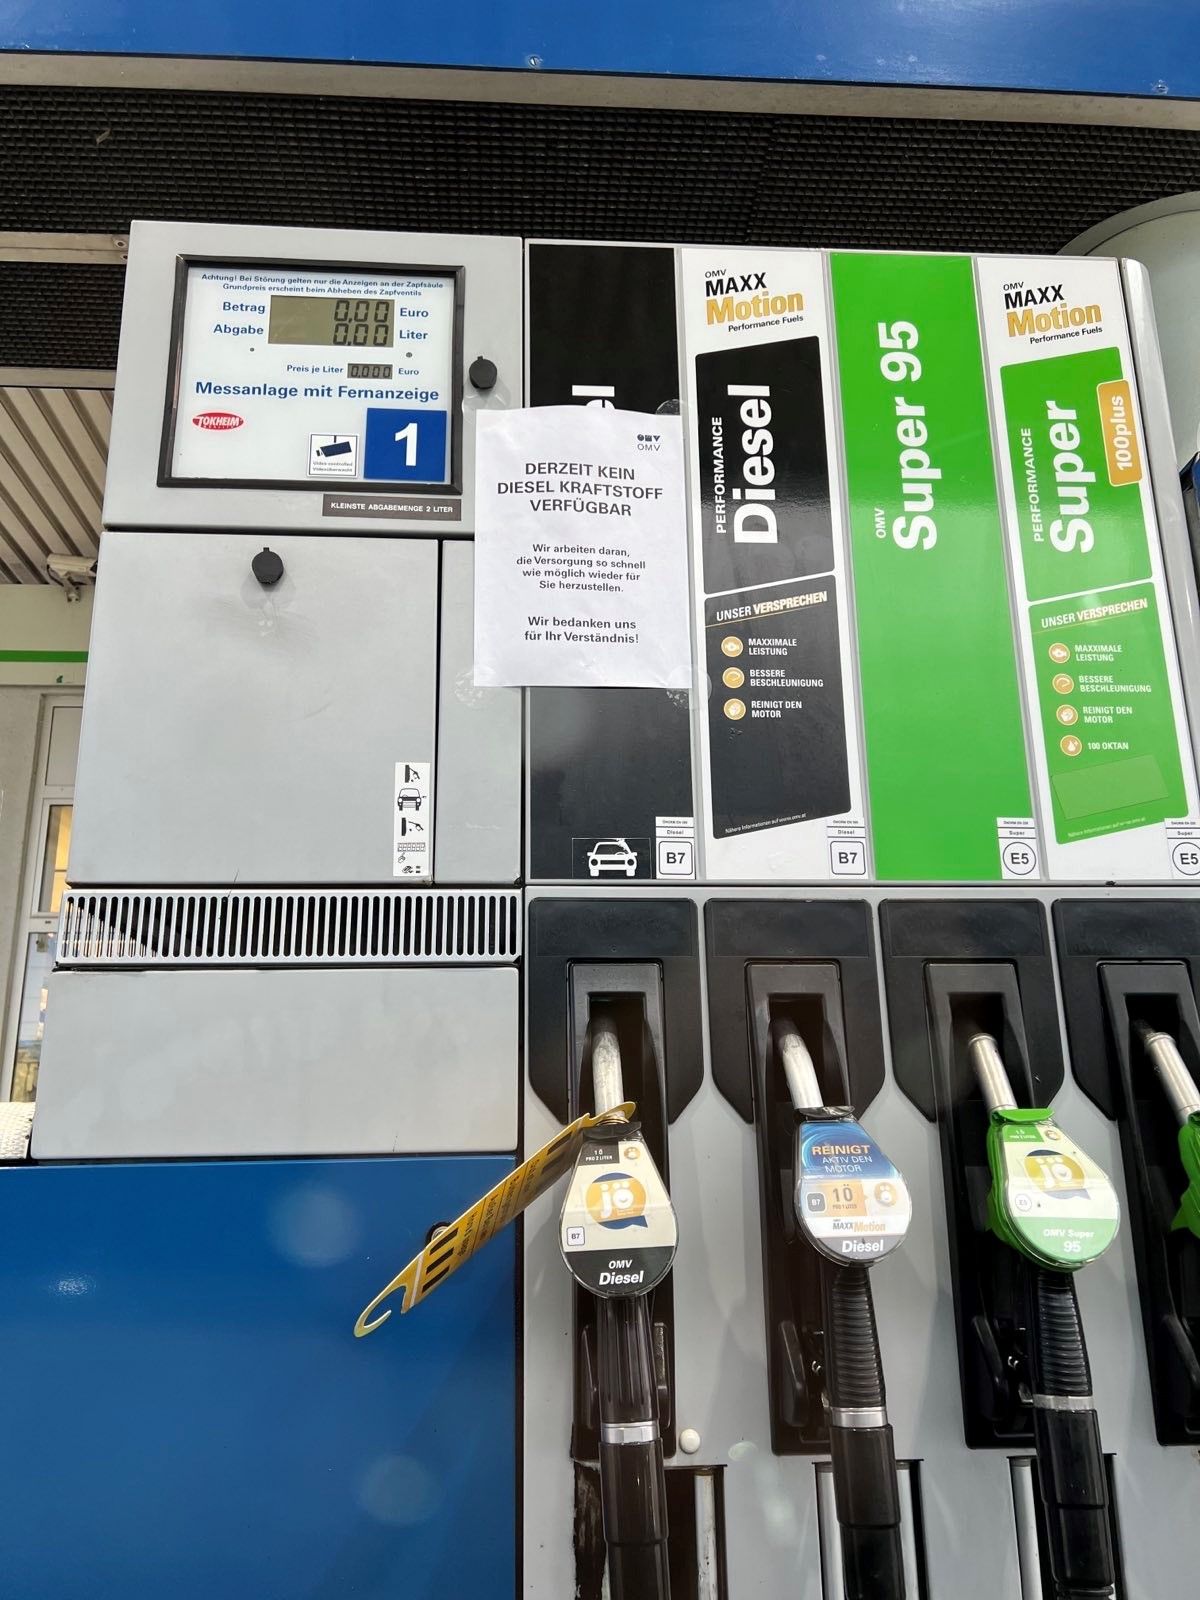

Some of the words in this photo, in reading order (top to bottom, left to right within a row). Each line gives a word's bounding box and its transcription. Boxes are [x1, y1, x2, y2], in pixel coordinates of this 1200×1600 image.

[705, 270, 726, 278] OMV
[202, 274, 237, 283] Achtung!
[254, 275, 286, 285] Störung
[288, 277, 312, 286] gelten
[329, 278, 341, 286] die
[342, 278, 378, 288] Anzeigen
[392, 280, 404, 288] der
[406, 281, 444, 290] Zapfsäule
[706, 272, 767, 297] MAXX
[1002, 281, 1024, 292] OMV
[222, 284, 266, 294] Grundpreis
[268, 284, 304, 293] erscheint
[306, 286, 326, 294] beim
[326, 286, 362, 294] Abheben
[379, 288, 422, 297] Zapfventils
[1004, 284, 1065, 310] MAXX
[222, 302, 266, 315] Betrag
[400, 308, 429, 318] Euro
[706, 291, 804, 326] Motion
[728, 318, 780, 332] Performance
[782, 315, 804, 324] Fuels
[1006, 304, 1102, 338] Motion
[214, 324, 264, 336] Abgabe
[399, 330, 428, 340] Liter
[1030, 330, 1080, 345] Performance
[1082, 326, 1103, 336] Fuels
[878, 320, 922, 382] 95
[286, 364, 310, 373] Preis
[312, 365, 320, 375] je
[322, 366, 344, 374] Liter
[398, 368, 420, 376] Euro
[196, 382, 298, 398] Messanlage
[304, 384, 332, 398] mit
[338, 386, 439, 402] Fernanzeige
[195, 416, 240, 428] TOKHEIM
[1110, 395, 1133, 470] 100plus
[394, 422, 418, 467] 1
[637, 444, 660, 452] OMV
[727, 384, 779, 544] Diesel
[525, 462, 593, 476] DERZEIT
[598, 466, 635, 480] KEIN
[712, 416, 726, 534] PERFORMANCE
[889, 396, 942, 550] Super
[1046, 400, 1096, 552] Super
[497, 480, 554, 495] DIESEL
[559, 482, 663, 500] KRAFTSTOFF
[1022, 428, 1044, 542] PERFORMANCE
[330, 502, 366, 511] KLEINSTE
[368, 503, 424, 512] ABGABEMENGE
[530, 497, 632, 516] VERFÜGBAR
[875, 508, 886, 538] OMV
[532, 544, 550, 552] Wir
[554, 544, 596, 554] arbeiten
[598, 547, 630, 558] daran,
[516, 556, 532, 565] die
[534, 556, 593, 568] Versorgung
[596, 560, 608, 568] so
[610, 559, 646, 570] schnell
[522, 568, 542, 578] wie
[544, 569, 585, 580] möglich
[588, 570, 622, 580] wieder
[626, 571, 640, 582] für
[539, 580, 556, 590] Sie
[558, 581, 624, 592] herzustellen.
[716, 606, 752, 622] UNSER
[752, 591, 828, 615] VERSPRECHEN
[1041, 612, 1076, 629] UNSER
[1076, 598, 1148, 622] VERSPRECHEN
[528, 616, 550, 626] Wir
[552, 616, 612, 629] bedanken
[614, 621, 636, 630] uns
[524, 630, 542, 641] für
[546, 632, 562, 641] Ihr
[564, 632, 639, 644] Verständnis!
[748, 638, 798, 648] MAXXIMALE
[749, 648, 788, 656] LEISTUNG
[1074, 644, 1122, 653] MAXXIMALE
[1076, 653, 1114, 662] LEISTUNG
[750, 669, 786, 678] BESSERE
[1078, 675, 1114, 684] BESSERE
[750, 678, 824, 688] BESCHLEUNIGUNG
[1080, 684, 1152, 693] BESCHLEUNIGUNG
[751, 700, 784, 710] REINIGT
[785, 700, 802, 709] DEN
[1083, 706, 1114, 714] REINIGT
[1116, 706, 1133, 714] DEN
[752, 710, 782, 718] MOTOR
[1084, 715, 1114, 724] MOTOR
[1088, 742, 1100, 750] 100
[1102, 742, 1129, 750] OKTAN
[666, 852, 686, 864] B7
[838, 852, 857, 864] B7
[1010, 852, 1029, 865] E5
[1180, 852, 1198, 865] E5
[812, 1144, 870, 1156] REINIGT
[822, 1156, 849, 1164] AKTIV
[826, 1164, 862, 1174] MOTOR
[600, 1180, 634, 1218] jö
[1043, 1228, 1066, 1237] OMV
[1067, 1230, 1094, 1239] Super
[842, 1240, 884, 1252] Diesel
[1064, 1241, 1081, 1252] 95
[608, 1260, 632, 1270] OMV
[599, 1270, 645, 1286] Diesel
